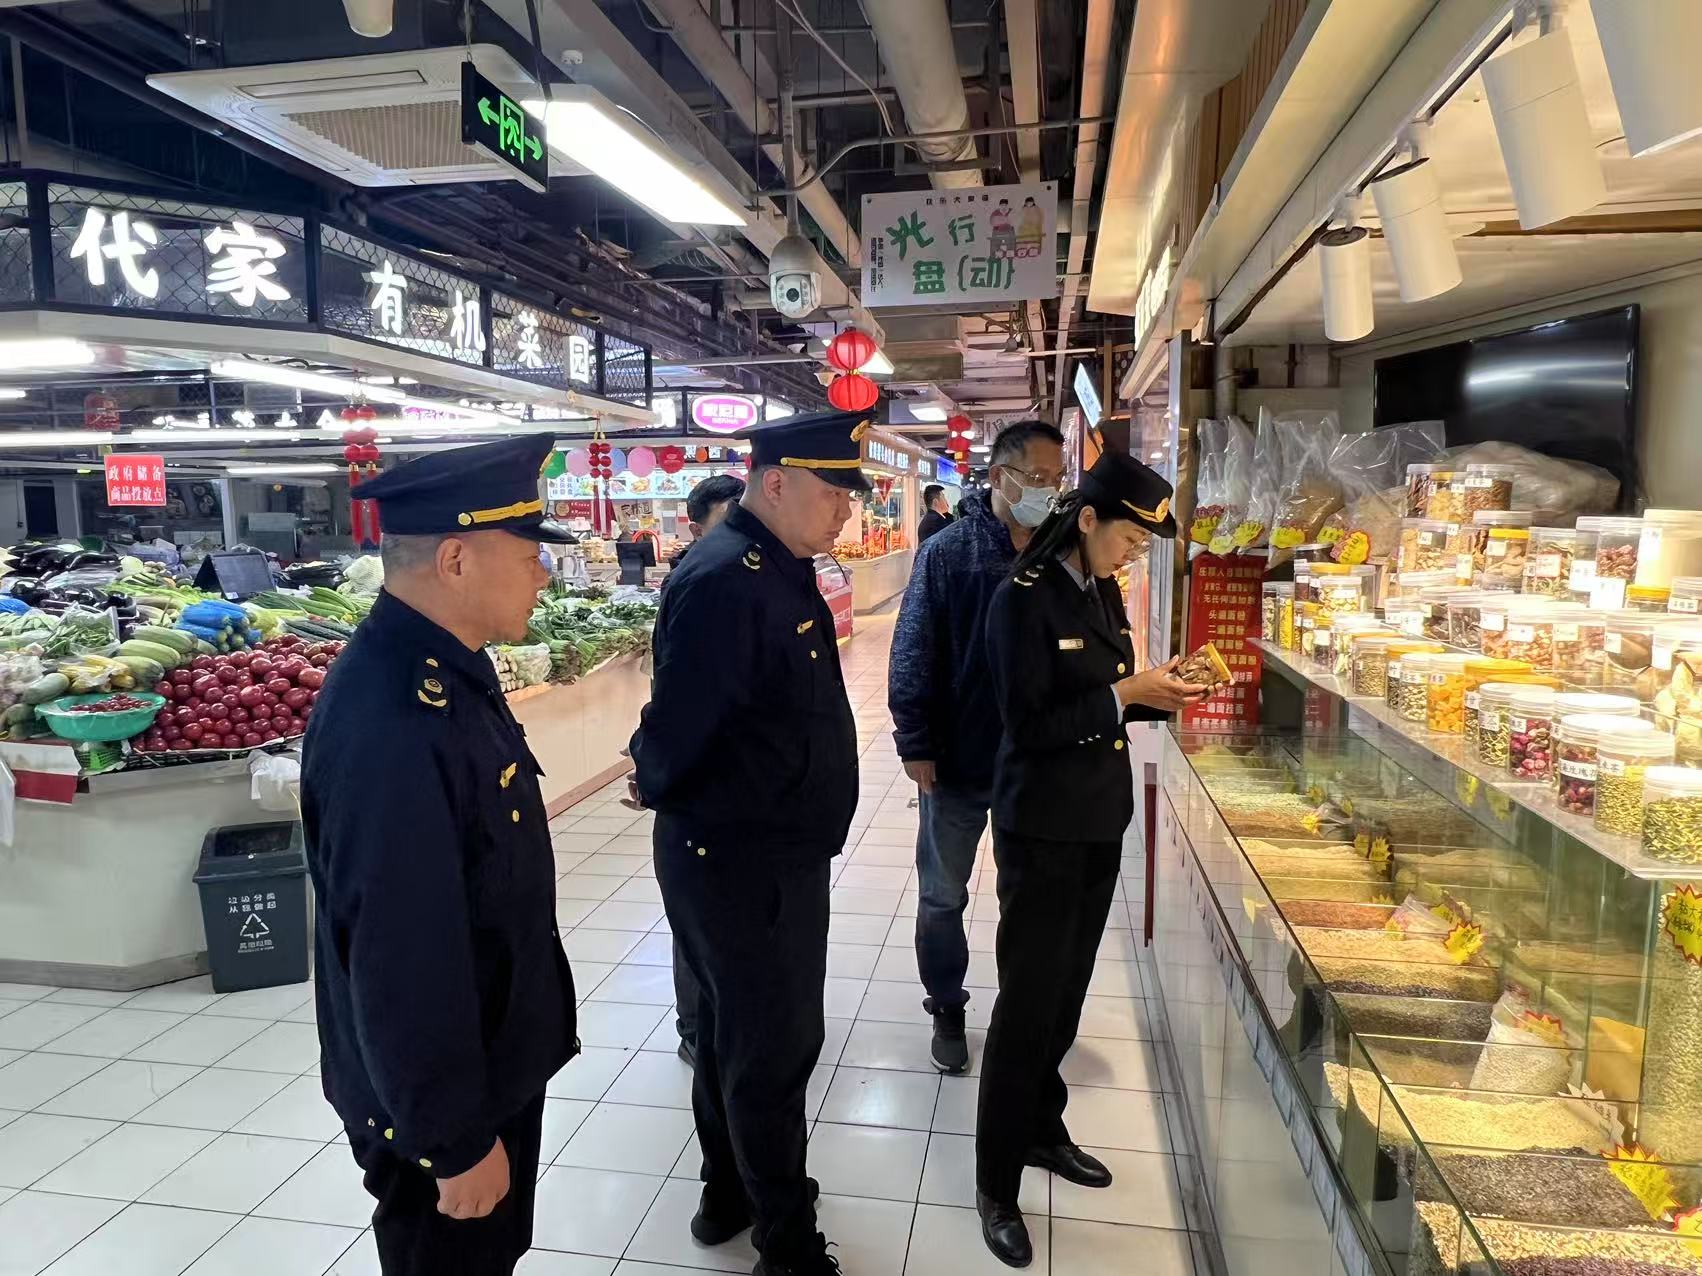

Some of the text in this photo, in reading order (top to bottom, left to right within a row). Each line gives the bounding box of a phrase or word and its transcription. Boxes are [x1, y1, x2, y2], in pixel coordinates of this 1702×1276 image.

[70, 206, 291, 307] 代家
[369, 259, 590, 384] 有机菜园
[228, 892, 276, 904] 垃圾分类
[229, 901, 277, 913] 从我做起
